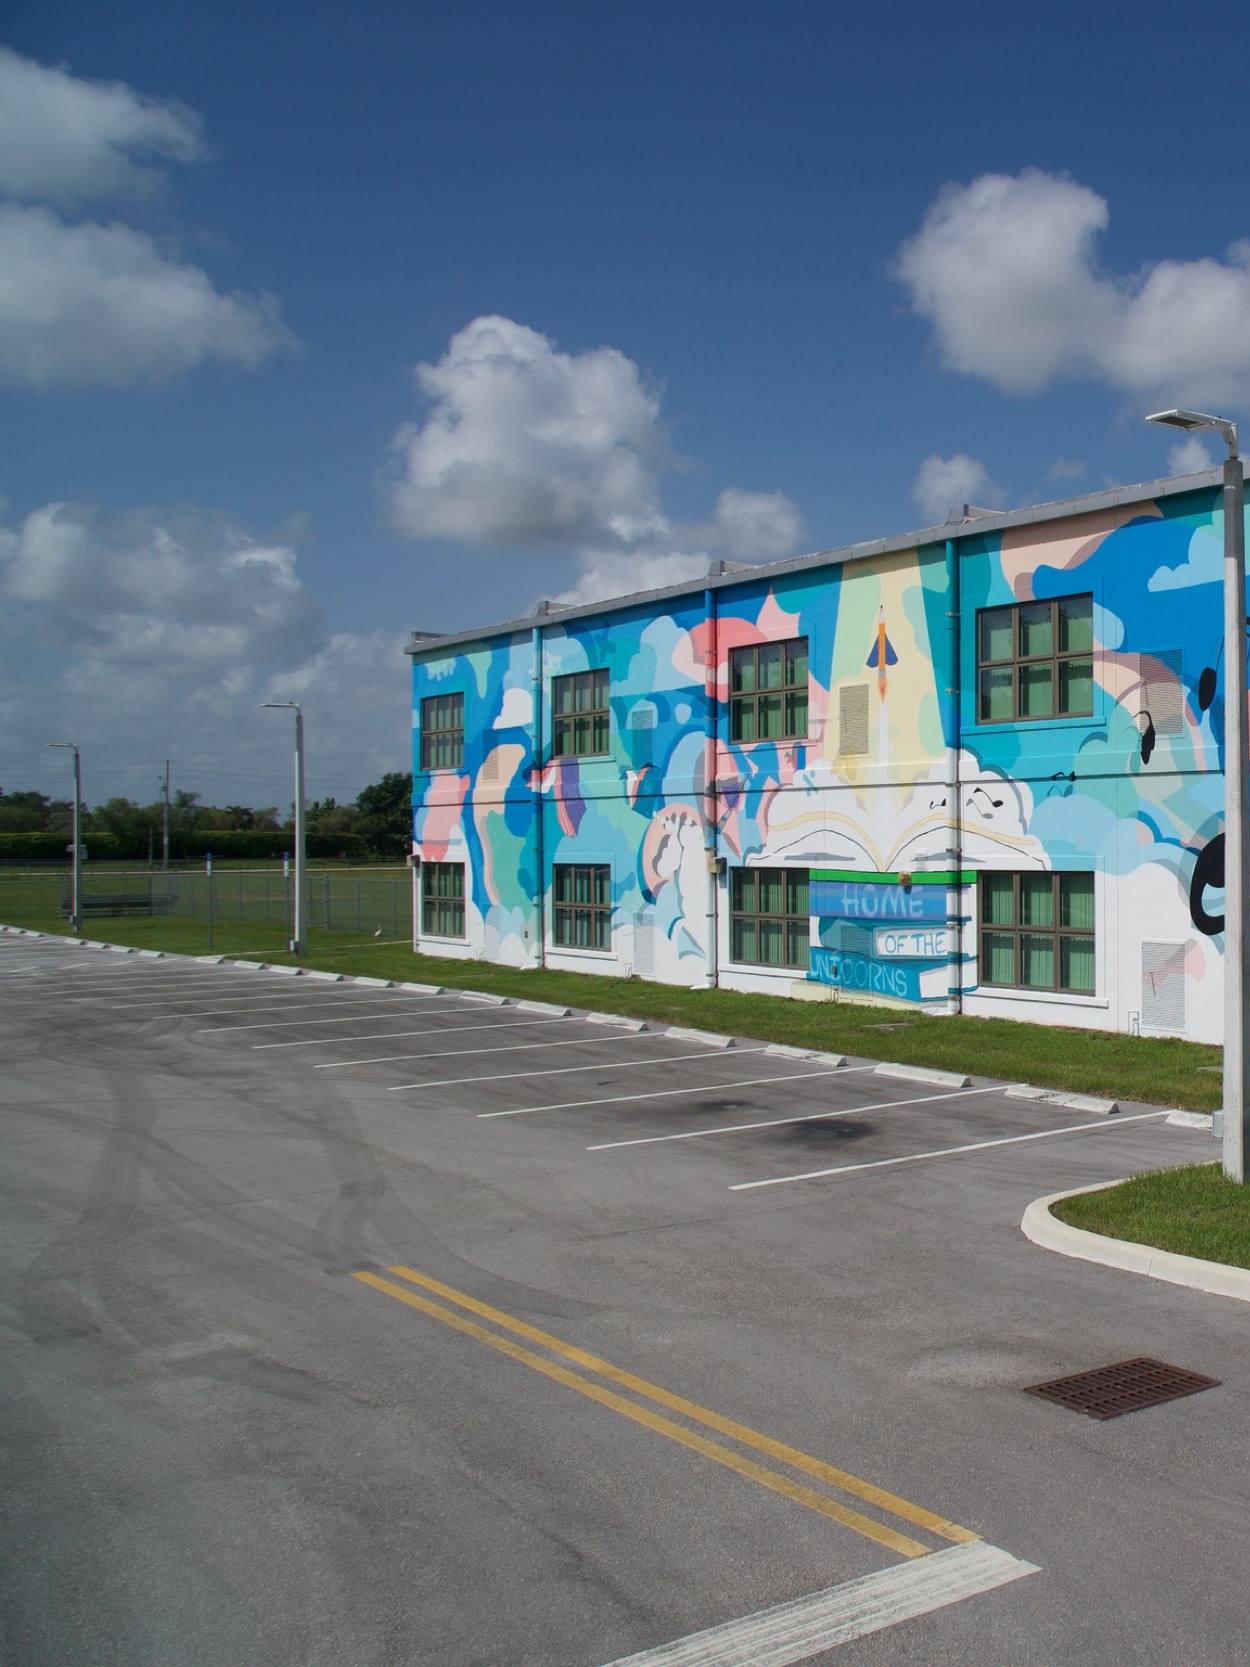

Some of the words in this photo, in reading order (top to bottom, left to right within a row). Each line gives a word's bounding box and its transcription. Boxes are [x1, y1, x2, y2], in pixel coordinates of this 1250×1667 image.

[842, 884, 923, 918] HOME
[885, 934, 907, 954] OF
[911, 932, 946, 954] THE
[809, 953, 908, 997] UNICORNS
